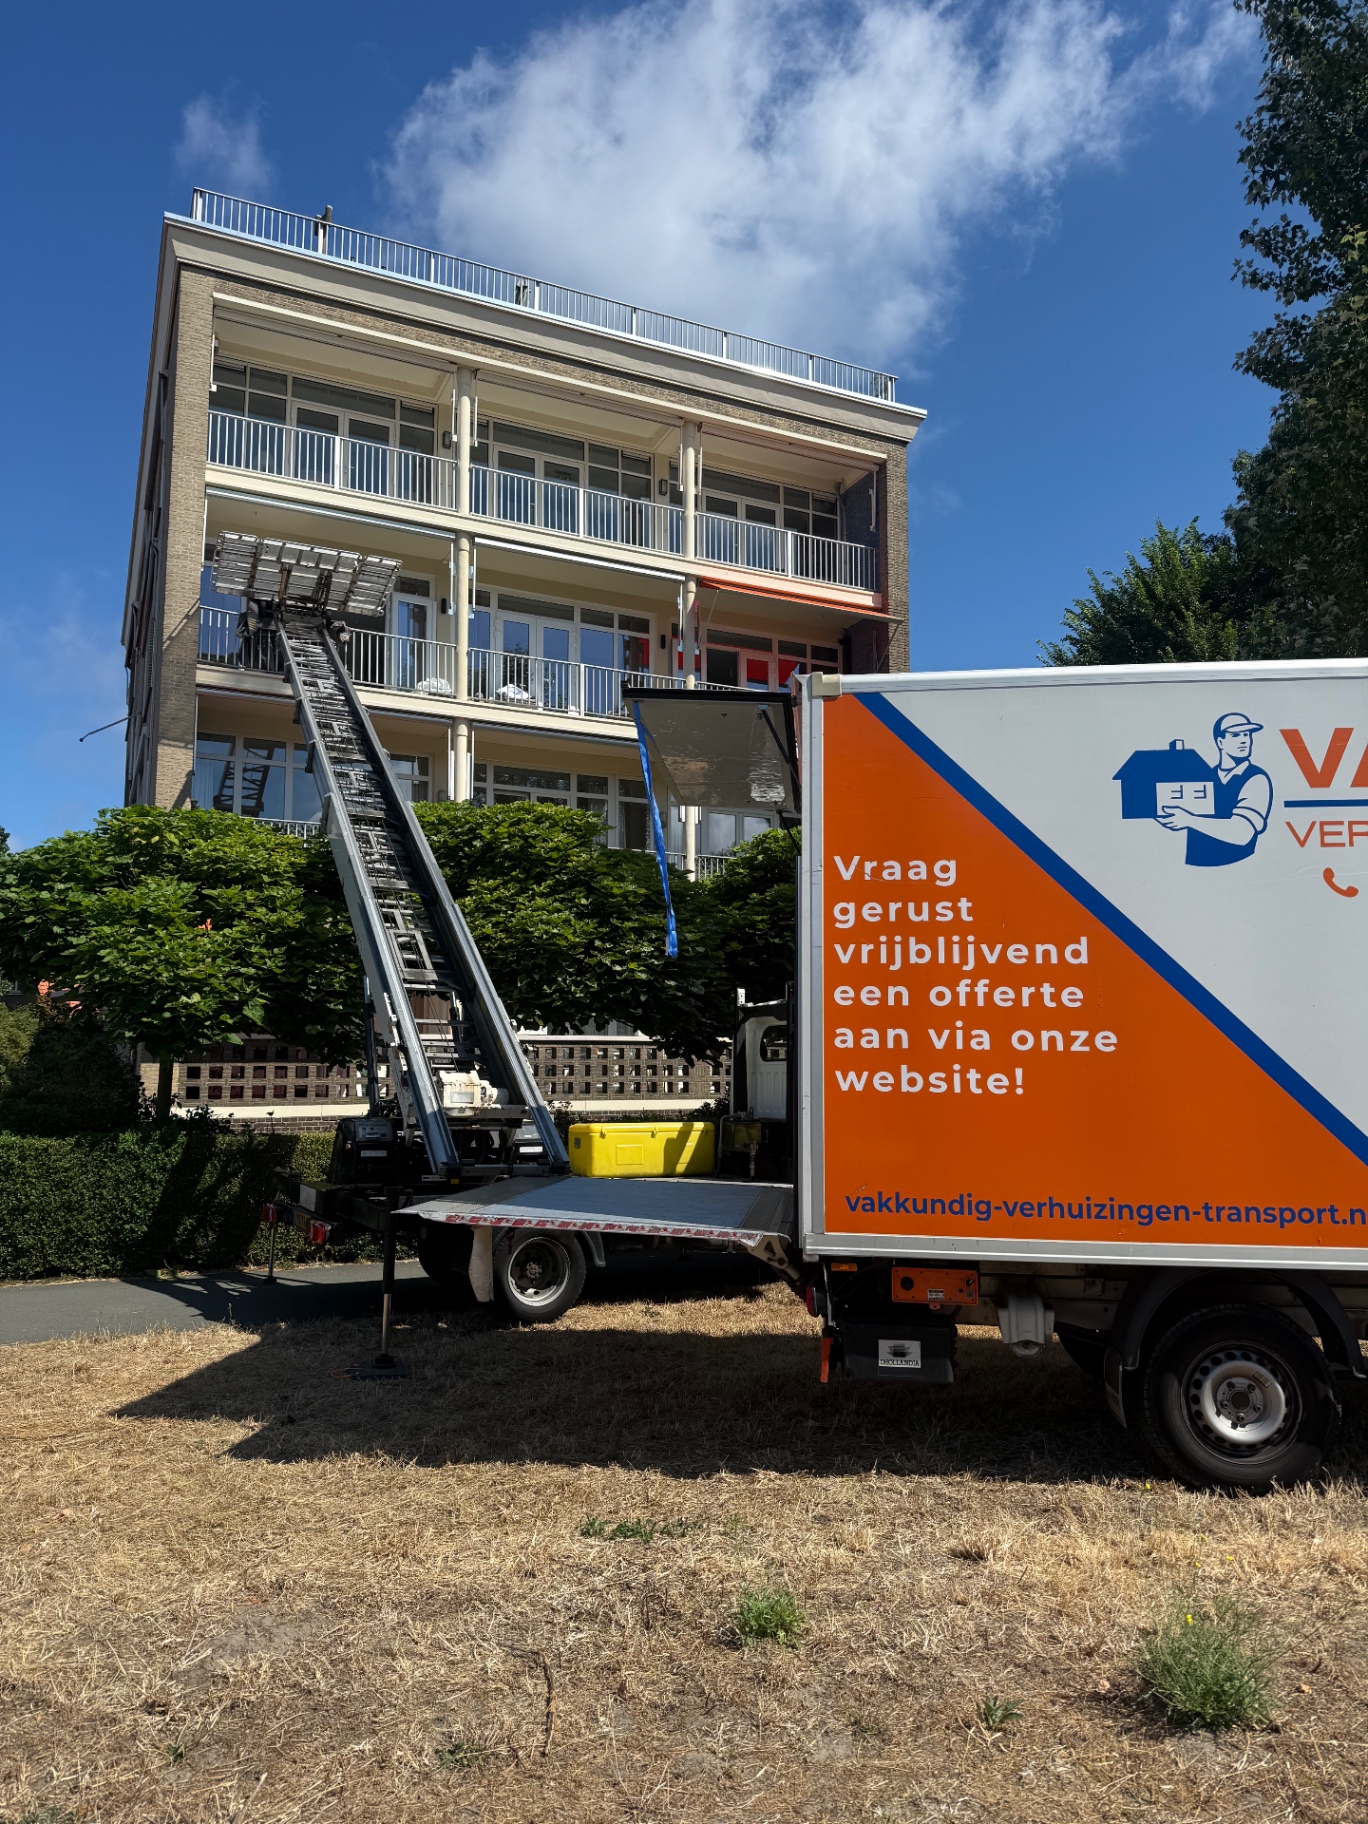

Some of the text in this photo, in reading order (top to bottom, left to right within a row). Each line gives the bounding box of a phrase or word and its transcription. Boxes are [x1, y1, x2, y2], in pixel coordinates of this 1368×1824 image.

[1279, 727, 1368, 789] V
[833, 855, 957, 887] Vraag
[833, 897, 974, 929] gerust
[833, 935, 1089, 971] vrijblijvend
[833, 978, 1084, 1008] een offerte
[834, 1020, 1118, 1053] aan via onze
[834, 1063, 1024, 1095] website!
[845, 1192, 1367, 1228] vakkundig-verhuizingen-transport.n
